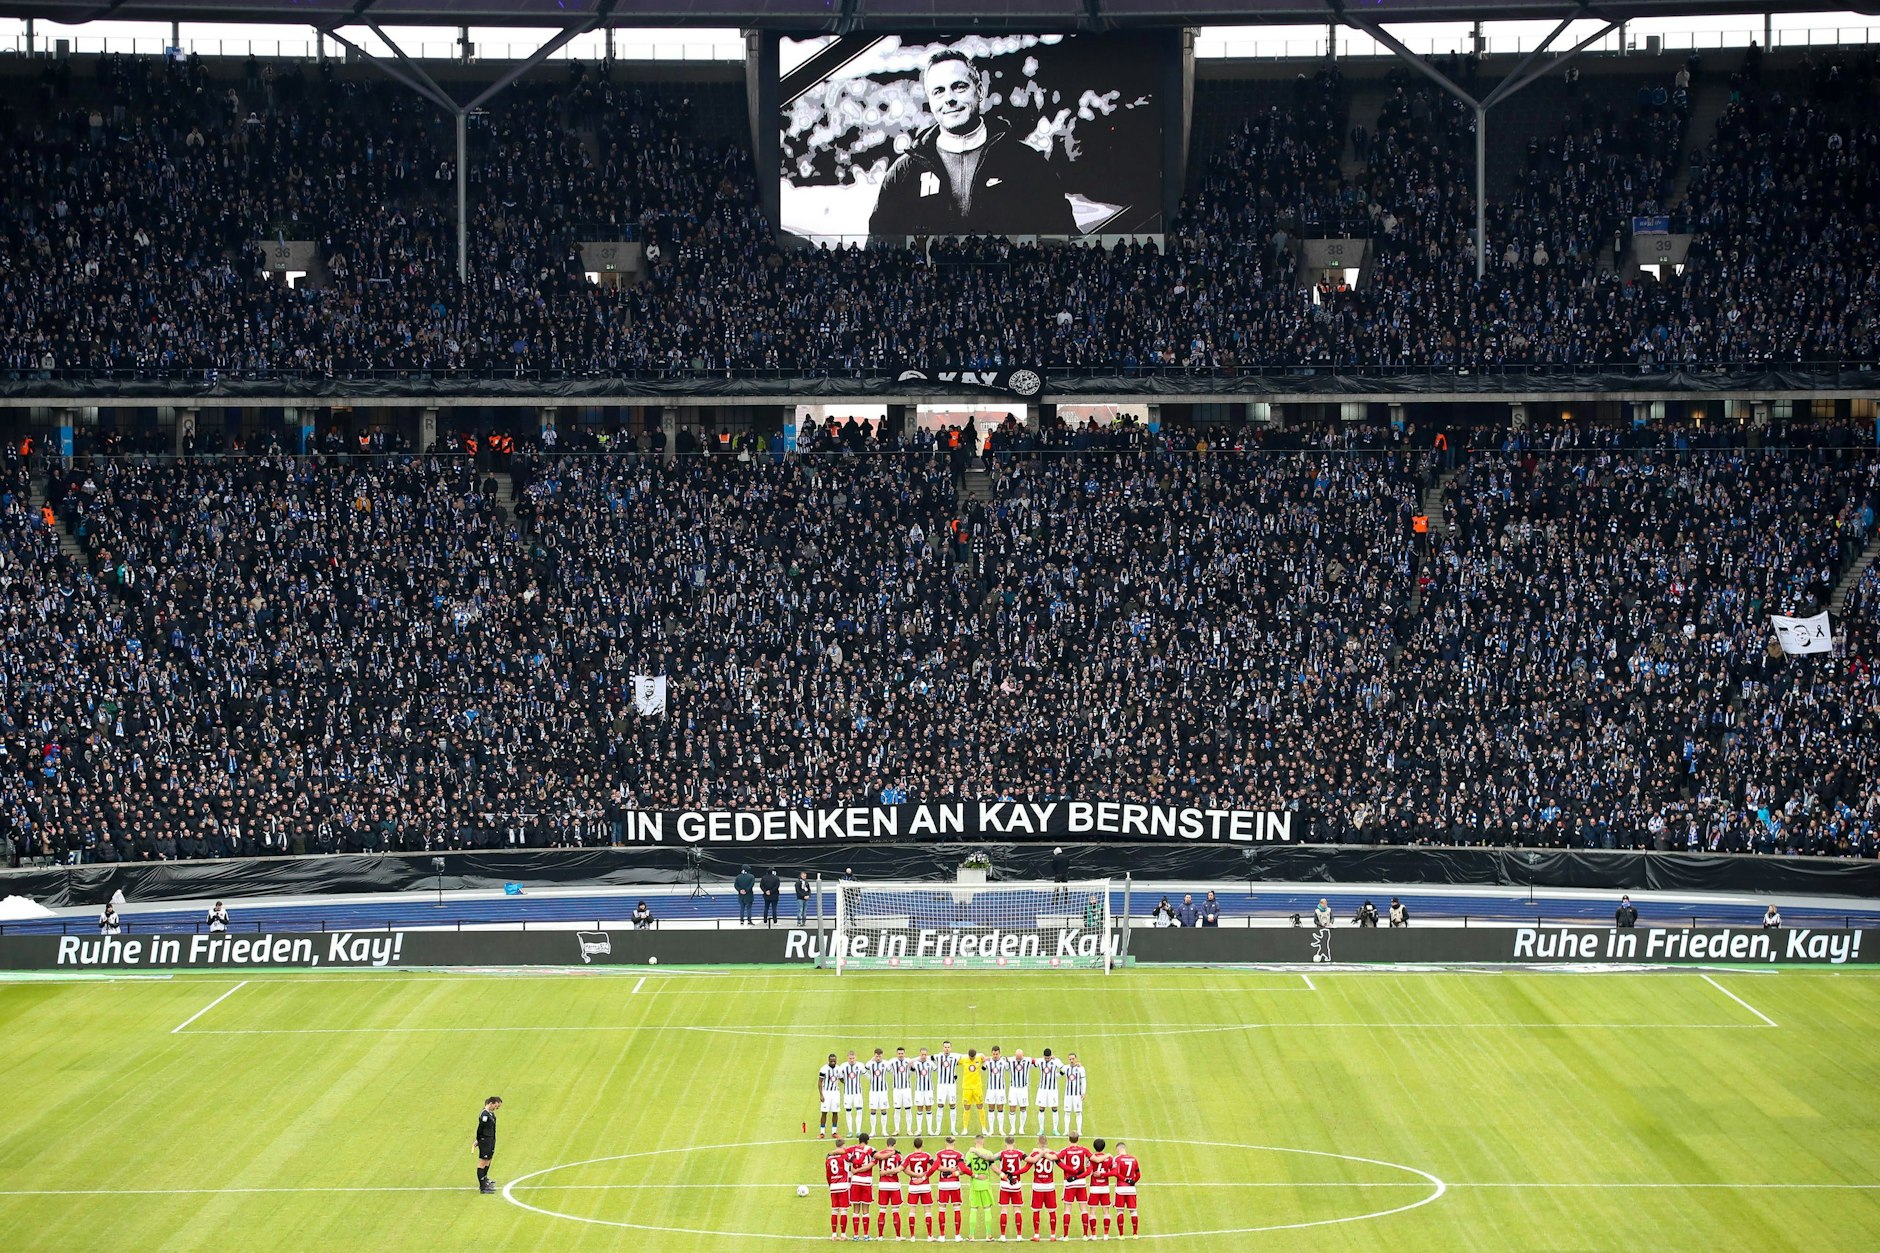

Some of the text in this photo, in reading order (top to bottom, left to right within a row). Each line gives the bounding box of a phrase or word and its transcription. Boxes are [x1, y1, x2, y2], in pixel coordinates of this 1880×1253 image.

[1328, 245, 1343, 255] 38
[1656, 241, 1672, 251] 39
[275, 248, 290, 258] 36
[601, 248, 617, 259] 37
[425, 418, 433, 430] R
[907, 417, 915, 428] R
[1029, 416, 1037, 427] S
[1514, 413, 1523, 425] S
[1756, 412, 1764, 423] T
[627, 802, 1292, 842] IN GEDENKEN AN KAY BERNSTEIN
[57, 932, 403, 966] Ruhe in Frieden, Kay!
[785, 930, 869, 958] Ruhe
[877, 929, 908, 957] in
[1513, 929, 1863, 964] Ruhe in Frieden, Kay!
[830, 1159, 839, 1174] 8
[914, 1161, 924, 1175] 6
[1006, 1158, 1015, 1173] 3
[1071, 1155, 1081, 1170] 9
[1124, 1161, 1133, 1177] 7
